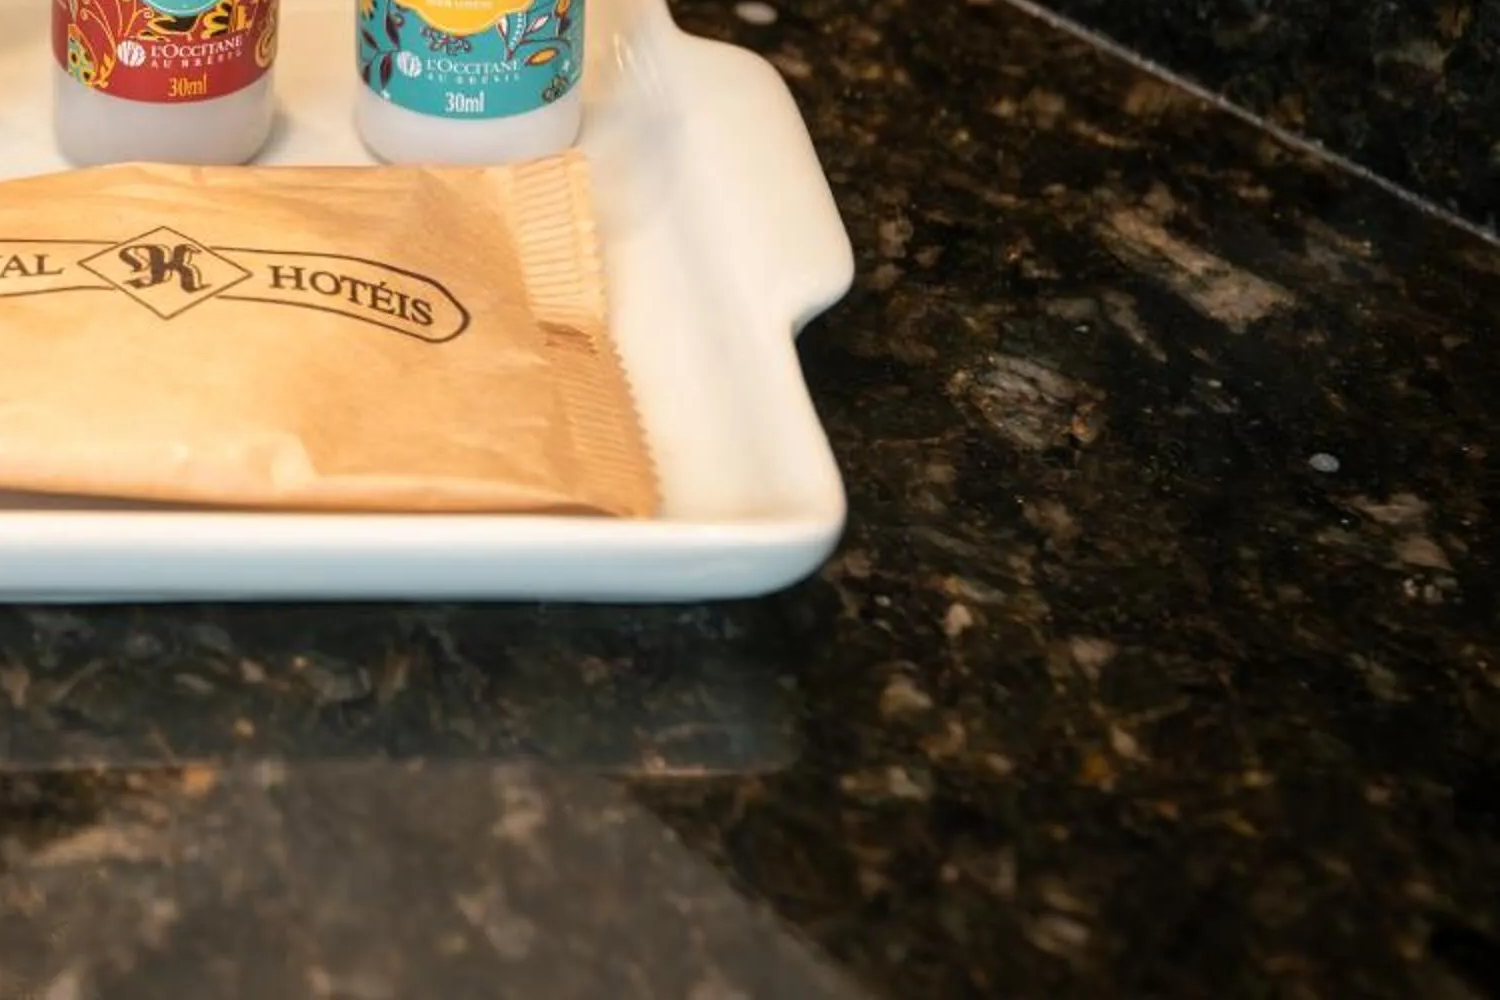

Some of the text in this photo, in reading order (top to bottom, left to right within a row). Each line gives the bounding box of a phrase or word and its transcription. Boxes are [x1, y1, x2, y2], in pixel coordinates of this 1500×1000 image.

[150, 35, 243, 59] L'OCCITANE
[167, 71, 208, 98] 30ml
[444, 89, 485, 113] 30ml
[267, 264, 435, 327] HOTÉIS
